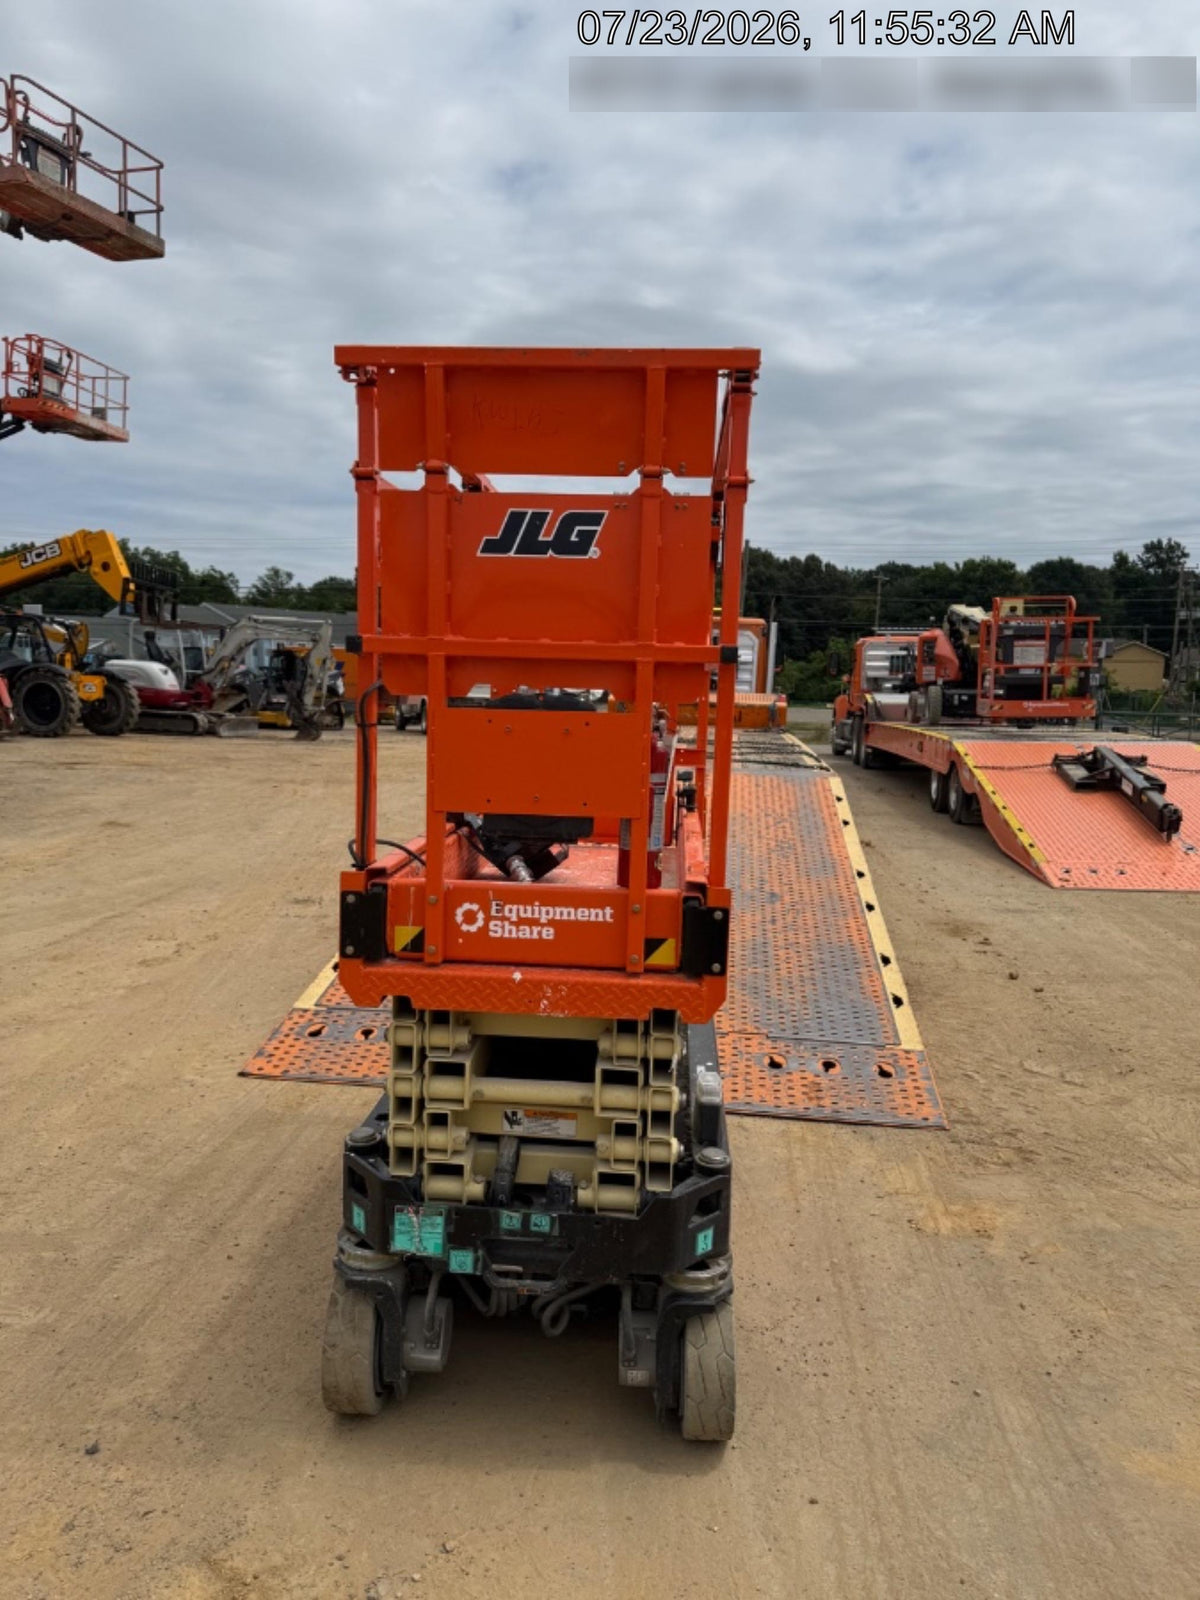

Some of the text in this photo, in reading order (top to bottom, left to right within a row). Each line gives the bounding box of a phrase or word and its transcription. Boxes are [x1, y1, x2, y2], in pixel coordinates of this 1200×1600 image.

[476, 508, 609, 558] JLG
[20, 543, 60, 568] JCB
[490, 900, 614, 923] Equipment
[488, 920, 555, 940] Share
